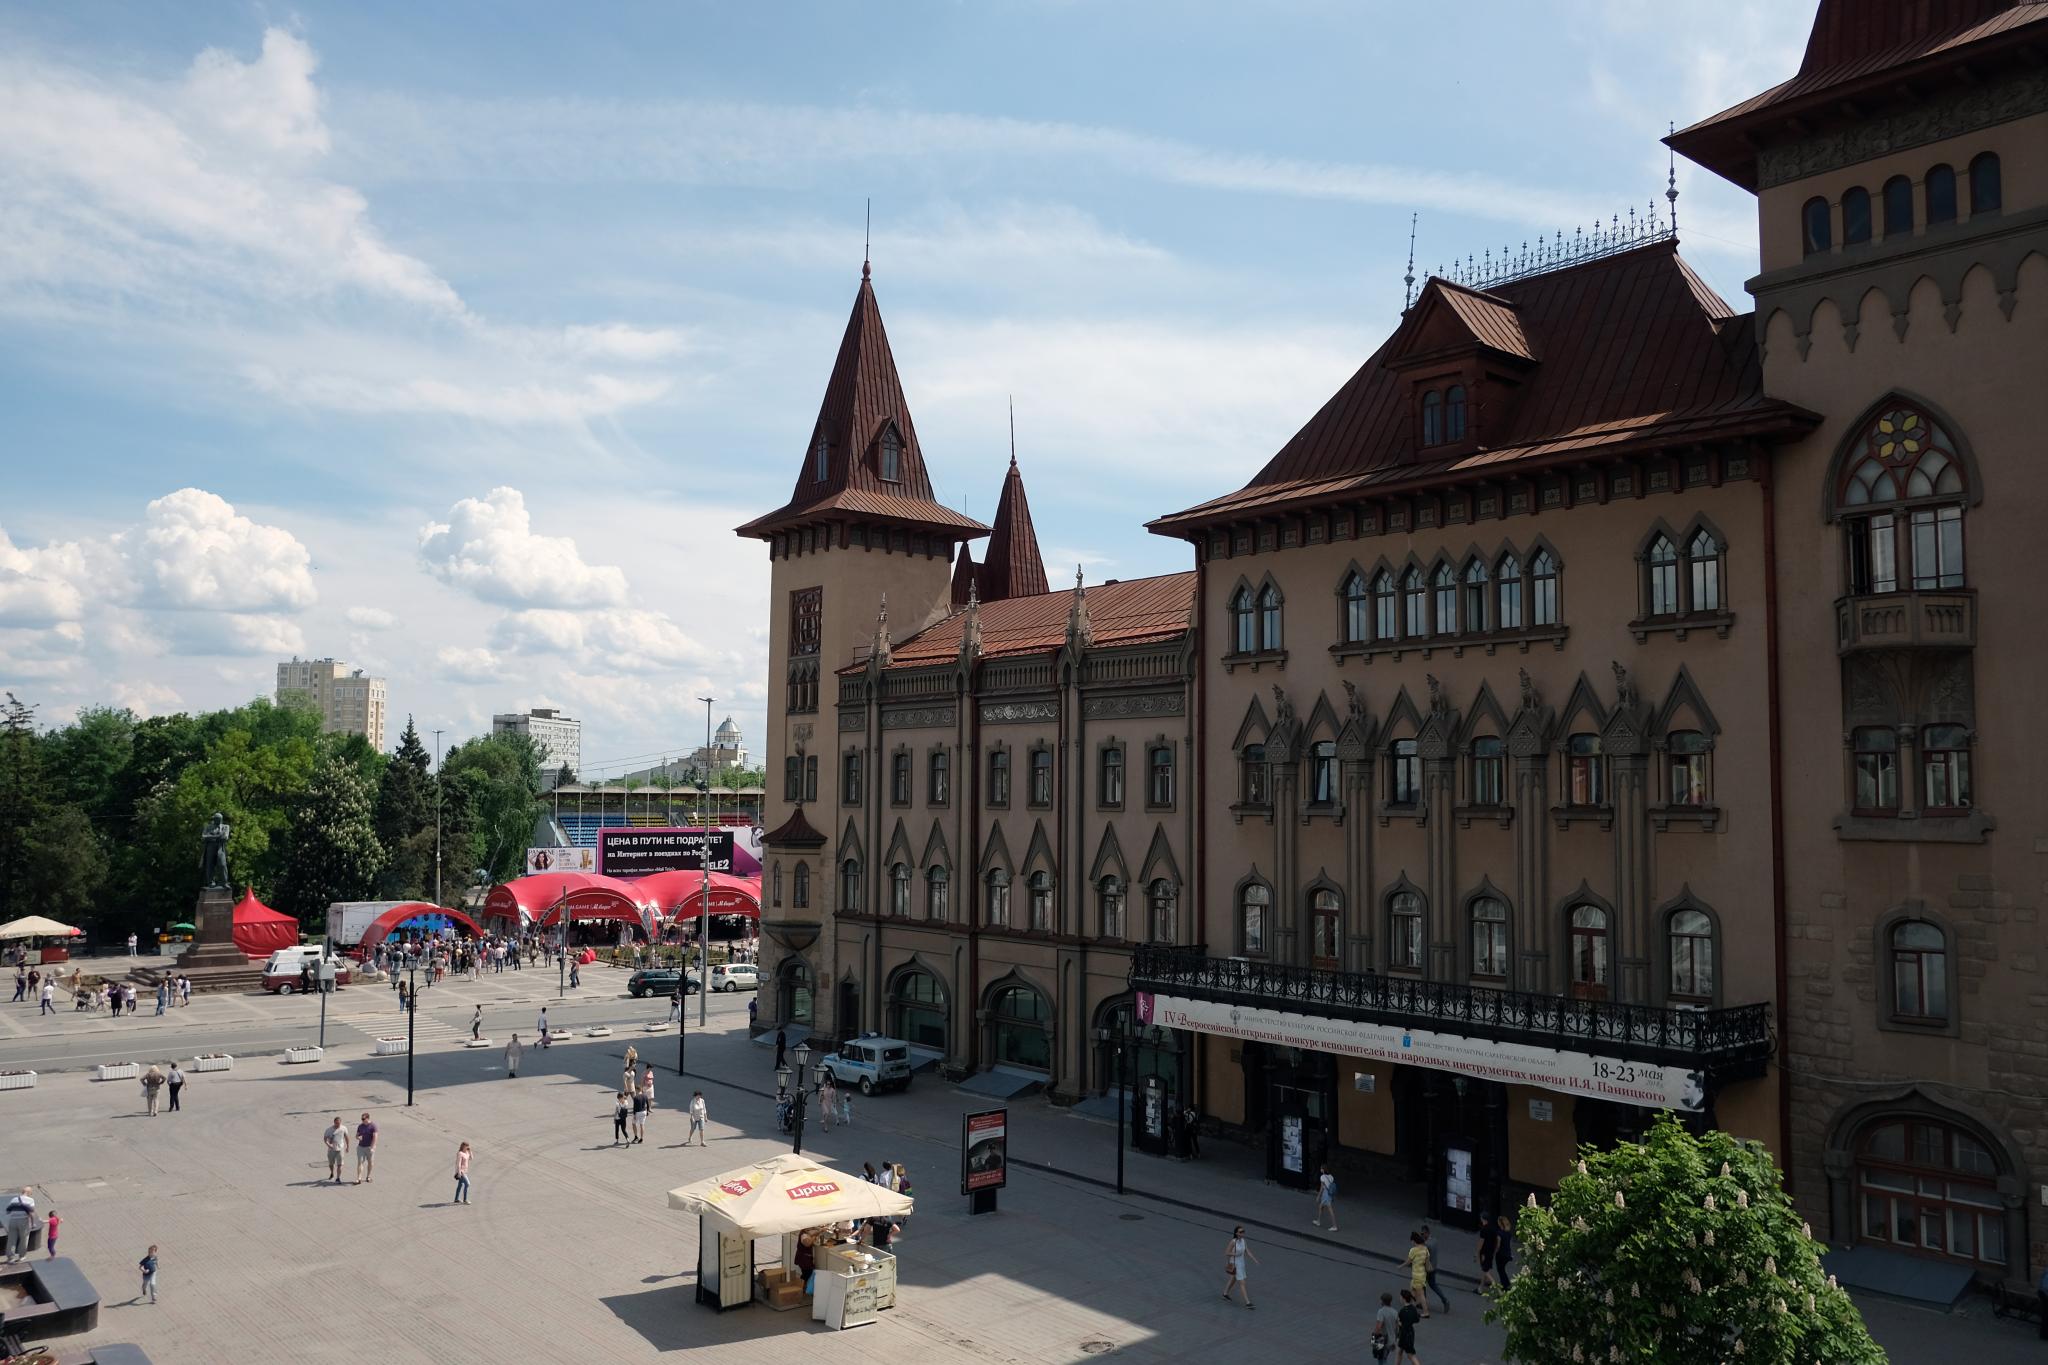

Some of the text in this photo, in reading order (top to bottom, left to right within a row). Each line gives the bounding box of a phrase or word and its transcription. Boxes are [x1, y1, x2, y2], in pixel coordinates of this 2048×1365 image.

[607, 835, 723, 847] ЦЕНА В ПУТИ НЕ ПОДРАТЕТ
[617, 850, 648, 859] Интернет
[1164, 1010, 1666, 1103] IV Всероссийский открытый конкурс исполнителей на народных инструментах имени И.Я. Паницкого
[1592, 1061, 1664, 1083] 18-23 мая
[791, 1184, 835, 1197] Lipton
